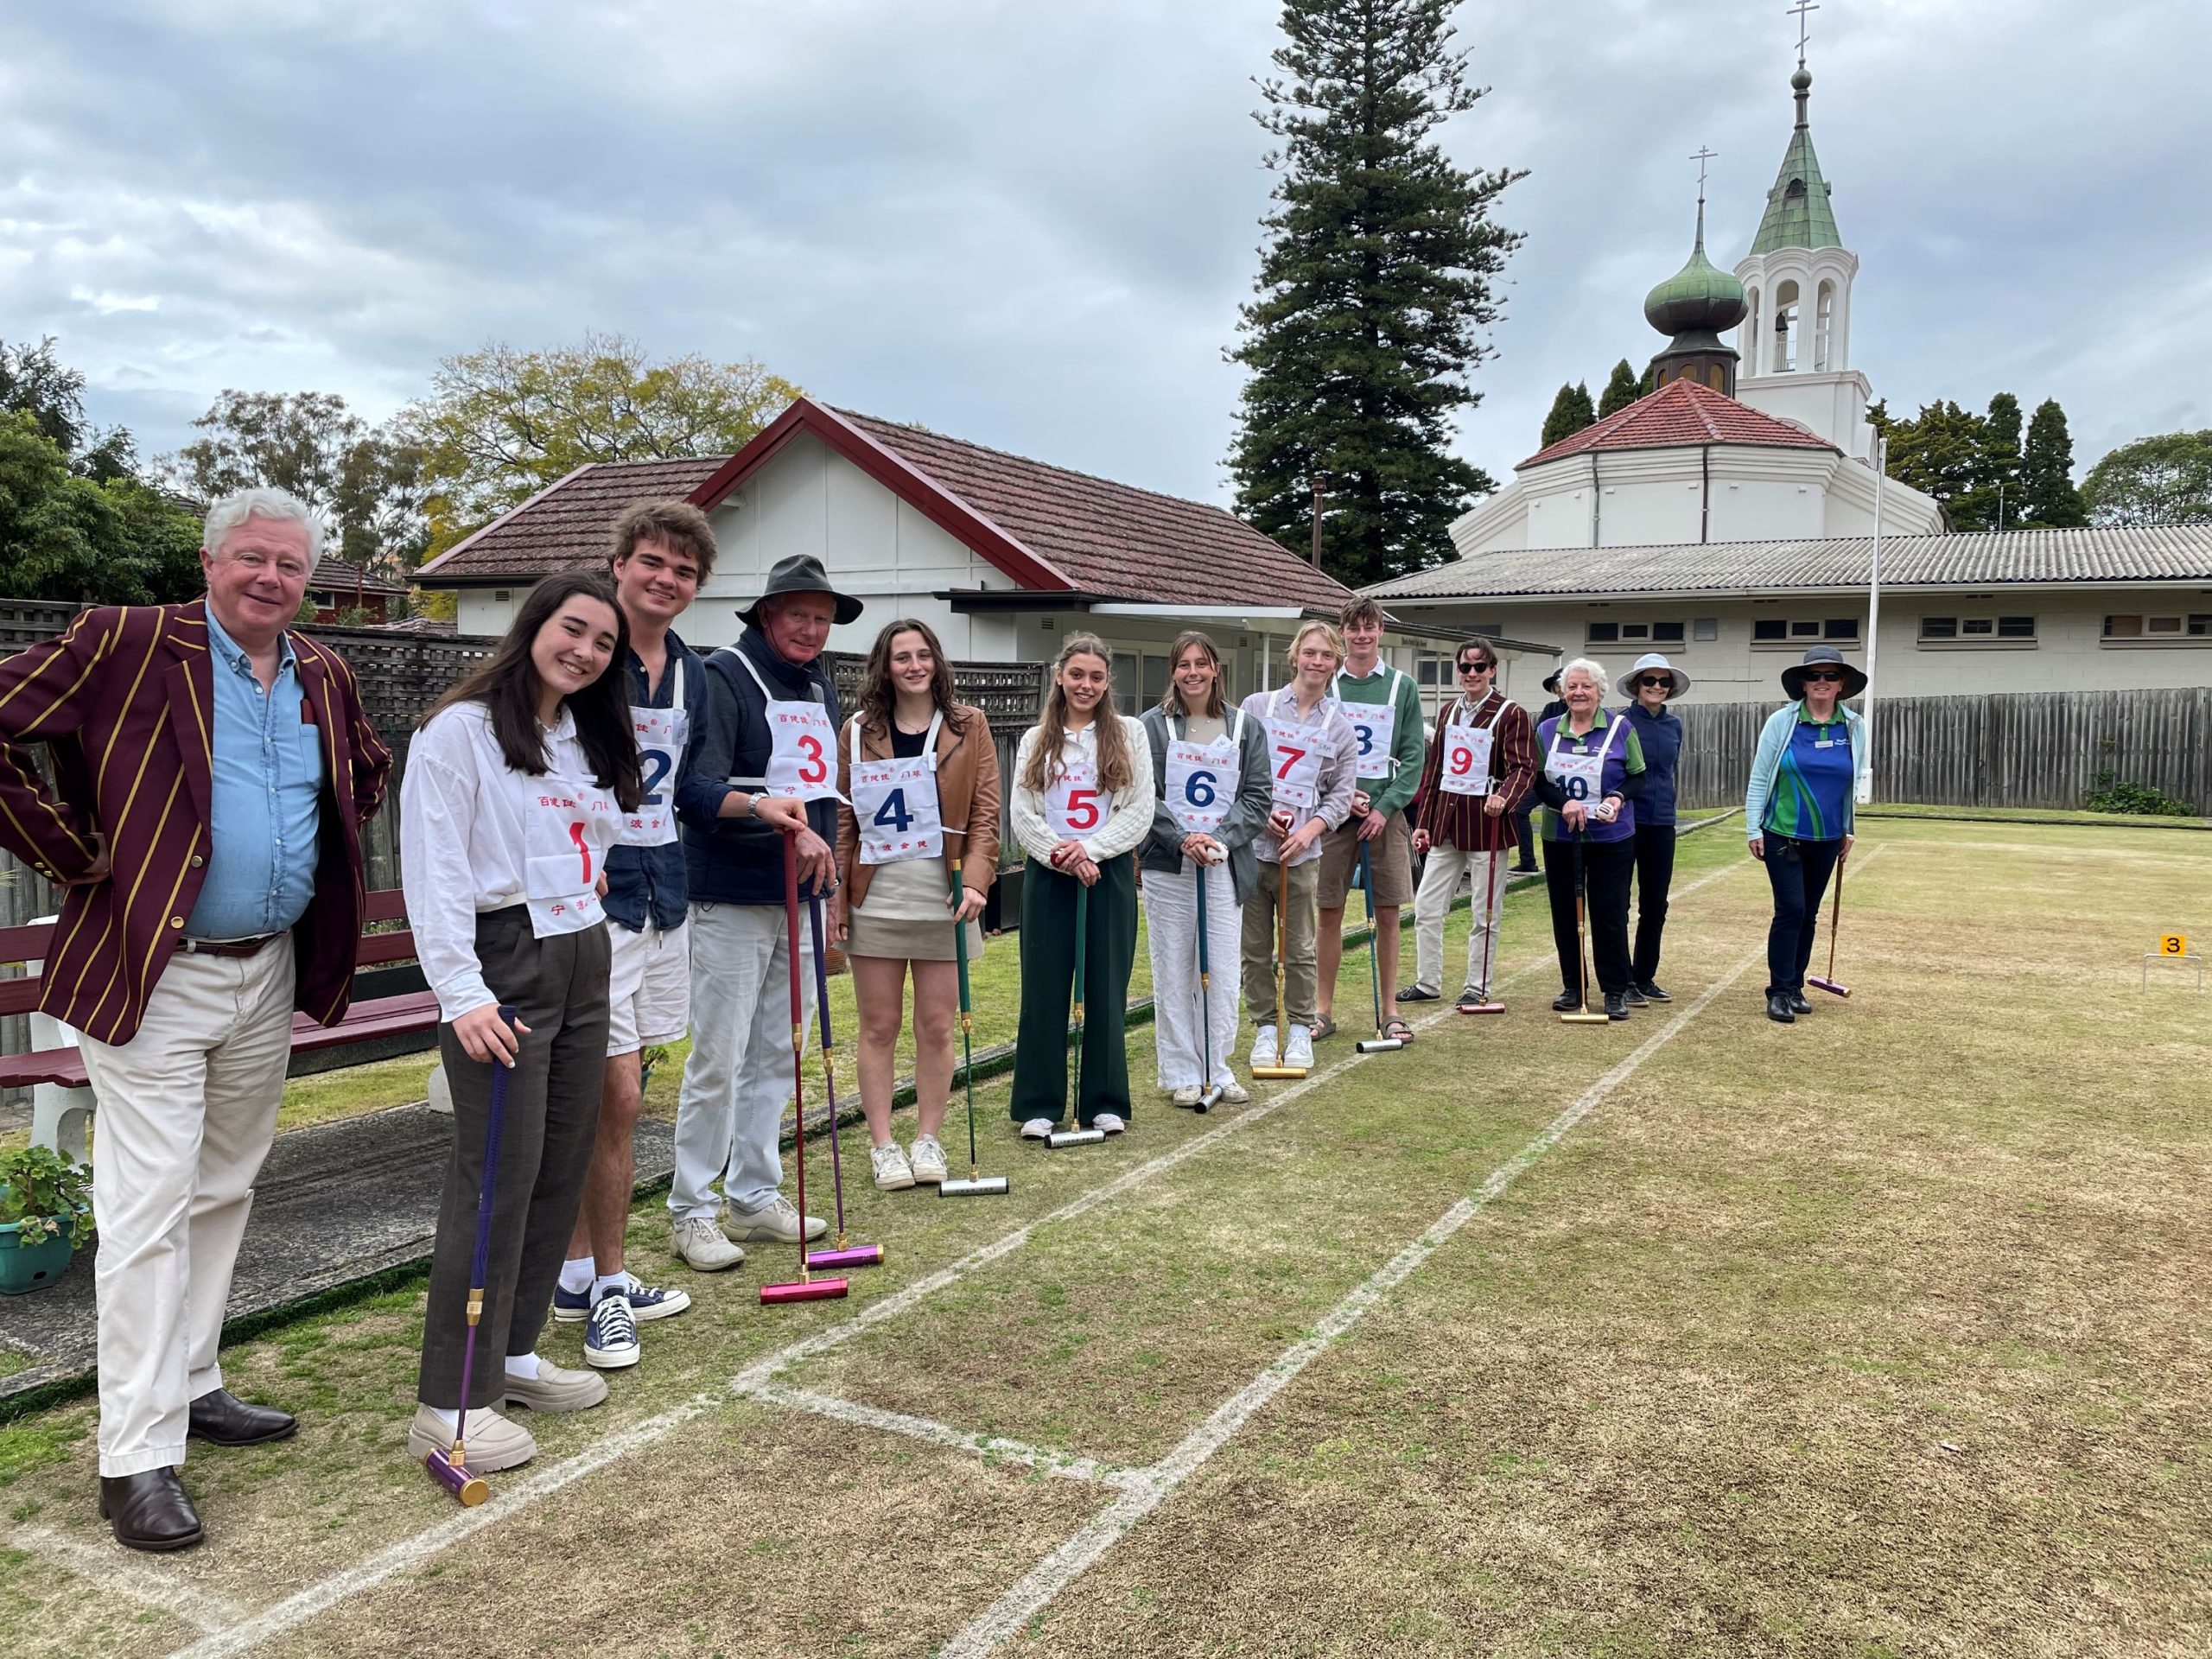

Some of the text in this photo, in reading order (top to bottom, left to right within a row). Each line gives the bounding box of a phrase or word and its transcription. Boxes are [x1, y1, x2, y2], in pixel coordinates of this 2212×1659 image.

[798, 734, 827, 782] 3
[1276, 745, 1306, 779] 7
[1450, 747, 1472, 775] 9
[638, 749, 671, 804] 2
[1185, 771, 1217, 807] 6
[1555, 775, 1588, 800] 10
[874, 788, 913, 832] 4
[1065, 790, 1099, 830] 5
[1281, 815, 1293, 830] 7
[569, 823, 592, 884] 1
[2166, 938, 2180, 953] 3
